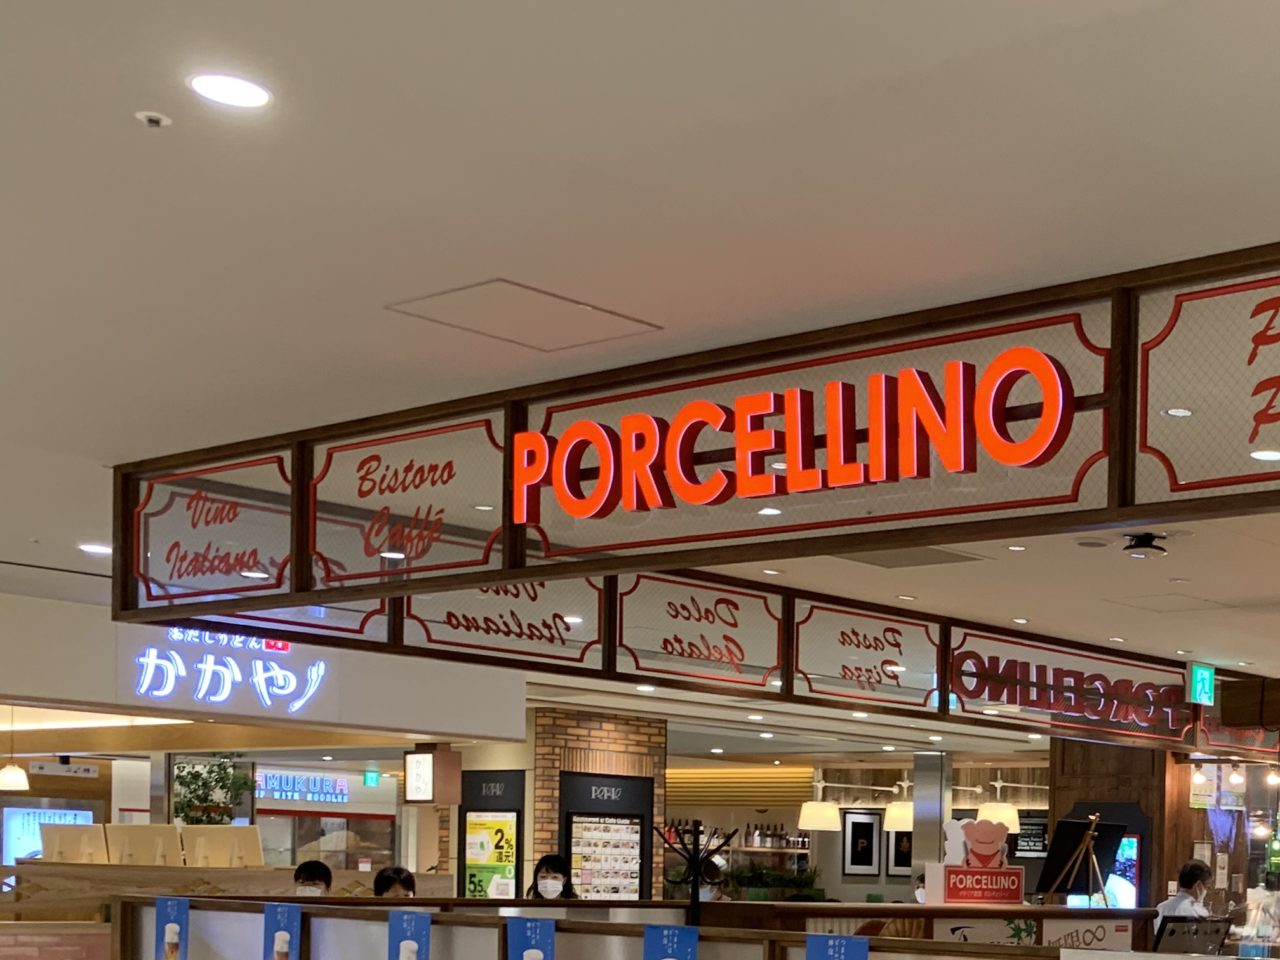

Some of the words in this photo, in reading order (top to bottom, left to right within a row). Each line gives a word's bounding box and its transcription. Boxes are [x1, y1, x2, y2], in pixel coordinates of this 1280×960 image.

[511, 344, 1077, 526] PORCELLINO
[356, 453, 458, 500] Bistoro
[186, 488, 240, 530] Vino
[165, 540, 262, 580] Italiano
[949, 874, 1019, 890] PORCELLINO
